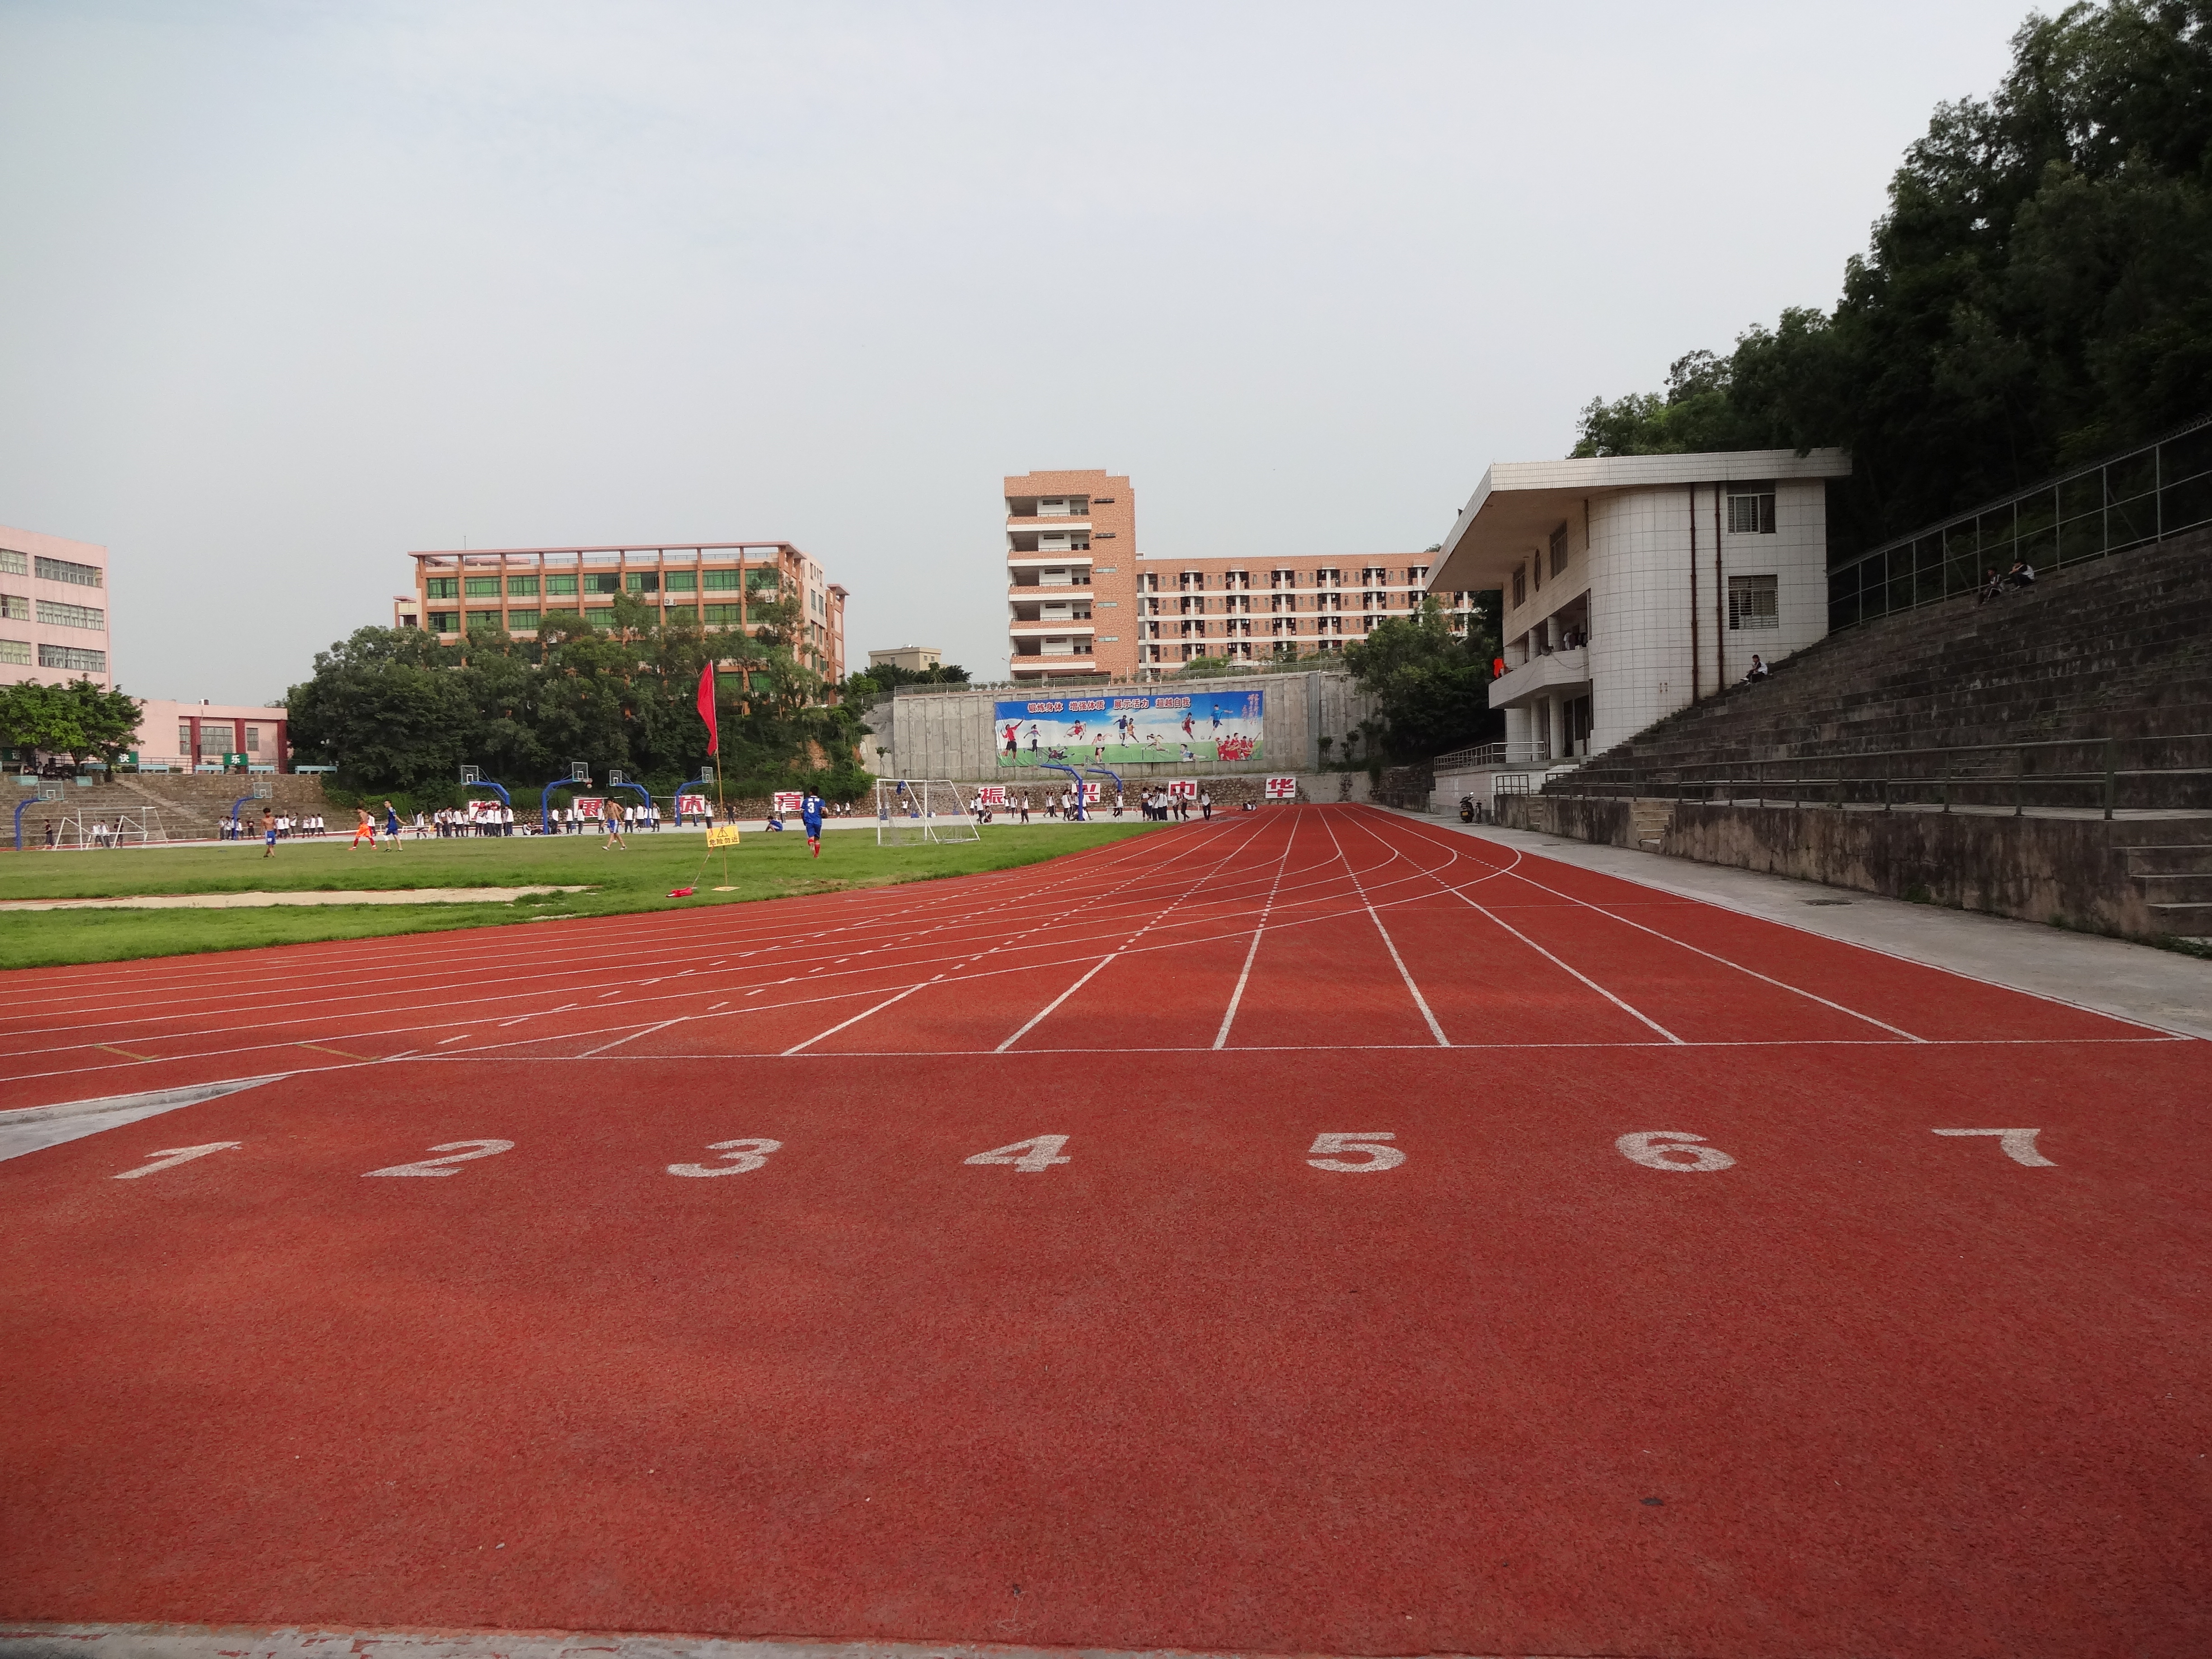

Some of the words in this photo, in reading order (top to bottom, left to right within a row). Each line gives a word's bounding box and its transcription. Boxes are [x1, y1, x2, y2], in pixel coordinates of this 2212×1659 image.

[1028, 702, 1064, 713] 锻炼身体
[1069, 700, 1106, 711] 增强体质
[1114, 698, 1150, 709] 展示活力
[1155, 697, 1191, 708] 超越自我
[231, 755, 240, 764] 乐
[980, 788, 1003, 804] 振
[1170, 781, 1195, 798] 中
[1267, 778, 1294, 797] 华
[775, 793, 803, 811] 育
[807, 801, 815, 814] 3
[709, 836, 739, 846] 危险勿近
[112, 1141, 242, 1179] 1
[361, 1139, 515, 1176] 2
[666, 1138, 783, 1176] 3
[963, 1134, 1071, 1172] 4
[1305, 1132, 1406, 1172] 5
[1615, 1131, 1737, 1172] 6
[1931, 1128, 2061, 1167] 7
